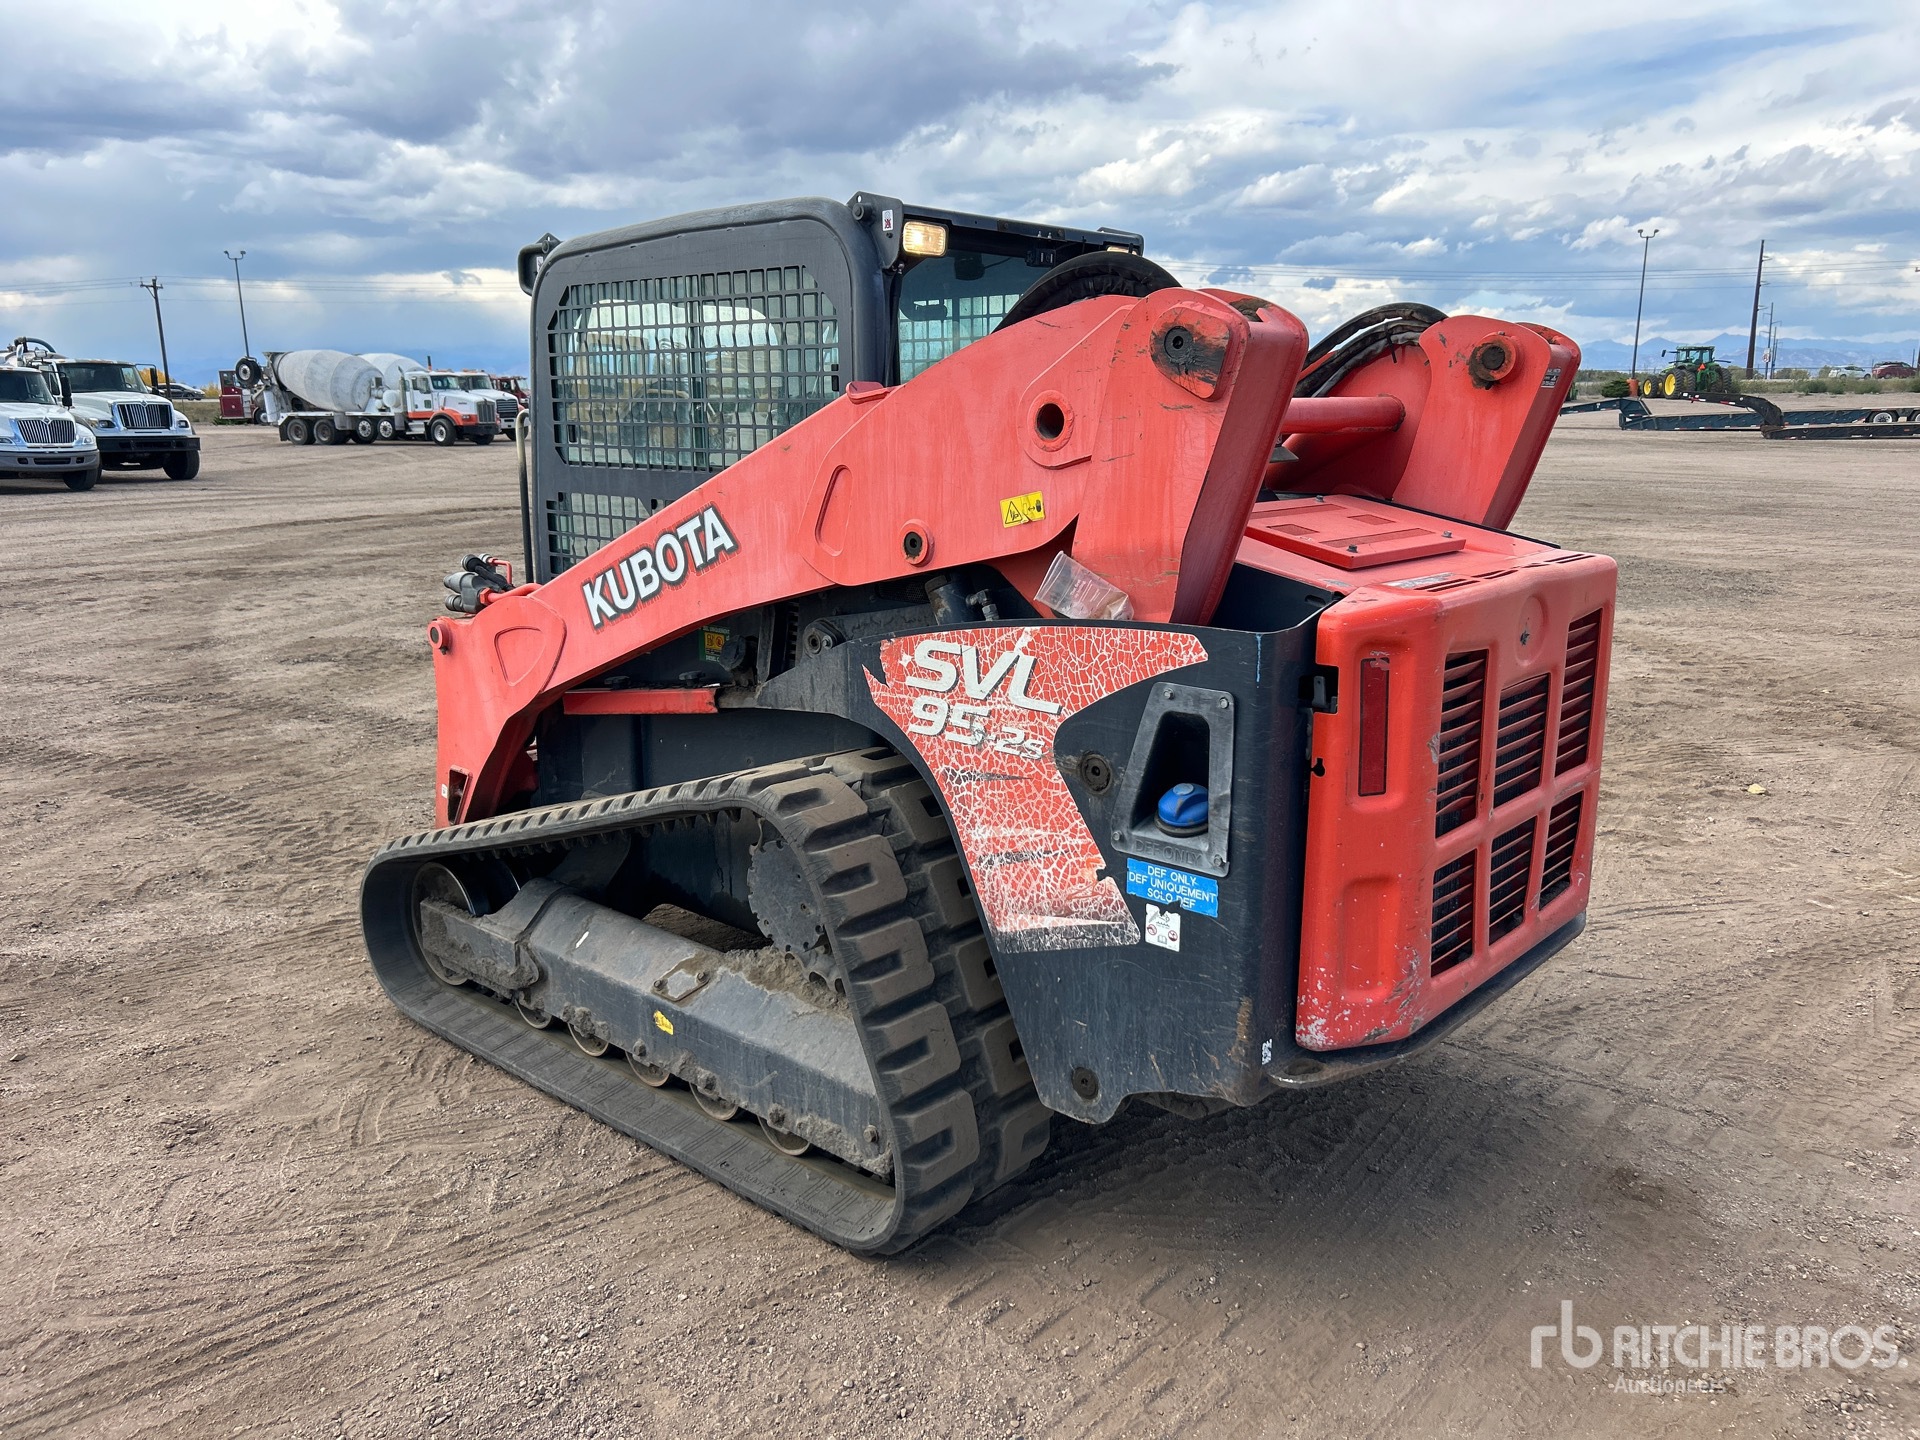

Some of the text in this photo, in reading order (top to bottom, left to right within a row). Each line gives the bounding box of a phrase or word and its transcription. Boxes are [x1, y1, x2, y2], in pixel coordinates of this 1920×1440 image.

[582, 507, 736, 627] KUBOTA
[905, 640, 1062, 715] SVL
[1135, 840, 1202, 867] DEF ONLY
[1128, 871, 1217, 903] DEF UNIQUEMENT
[1147, 865, 1198, 887] DEF ONLY
[1147, 888, 1173, 902] SOLO
